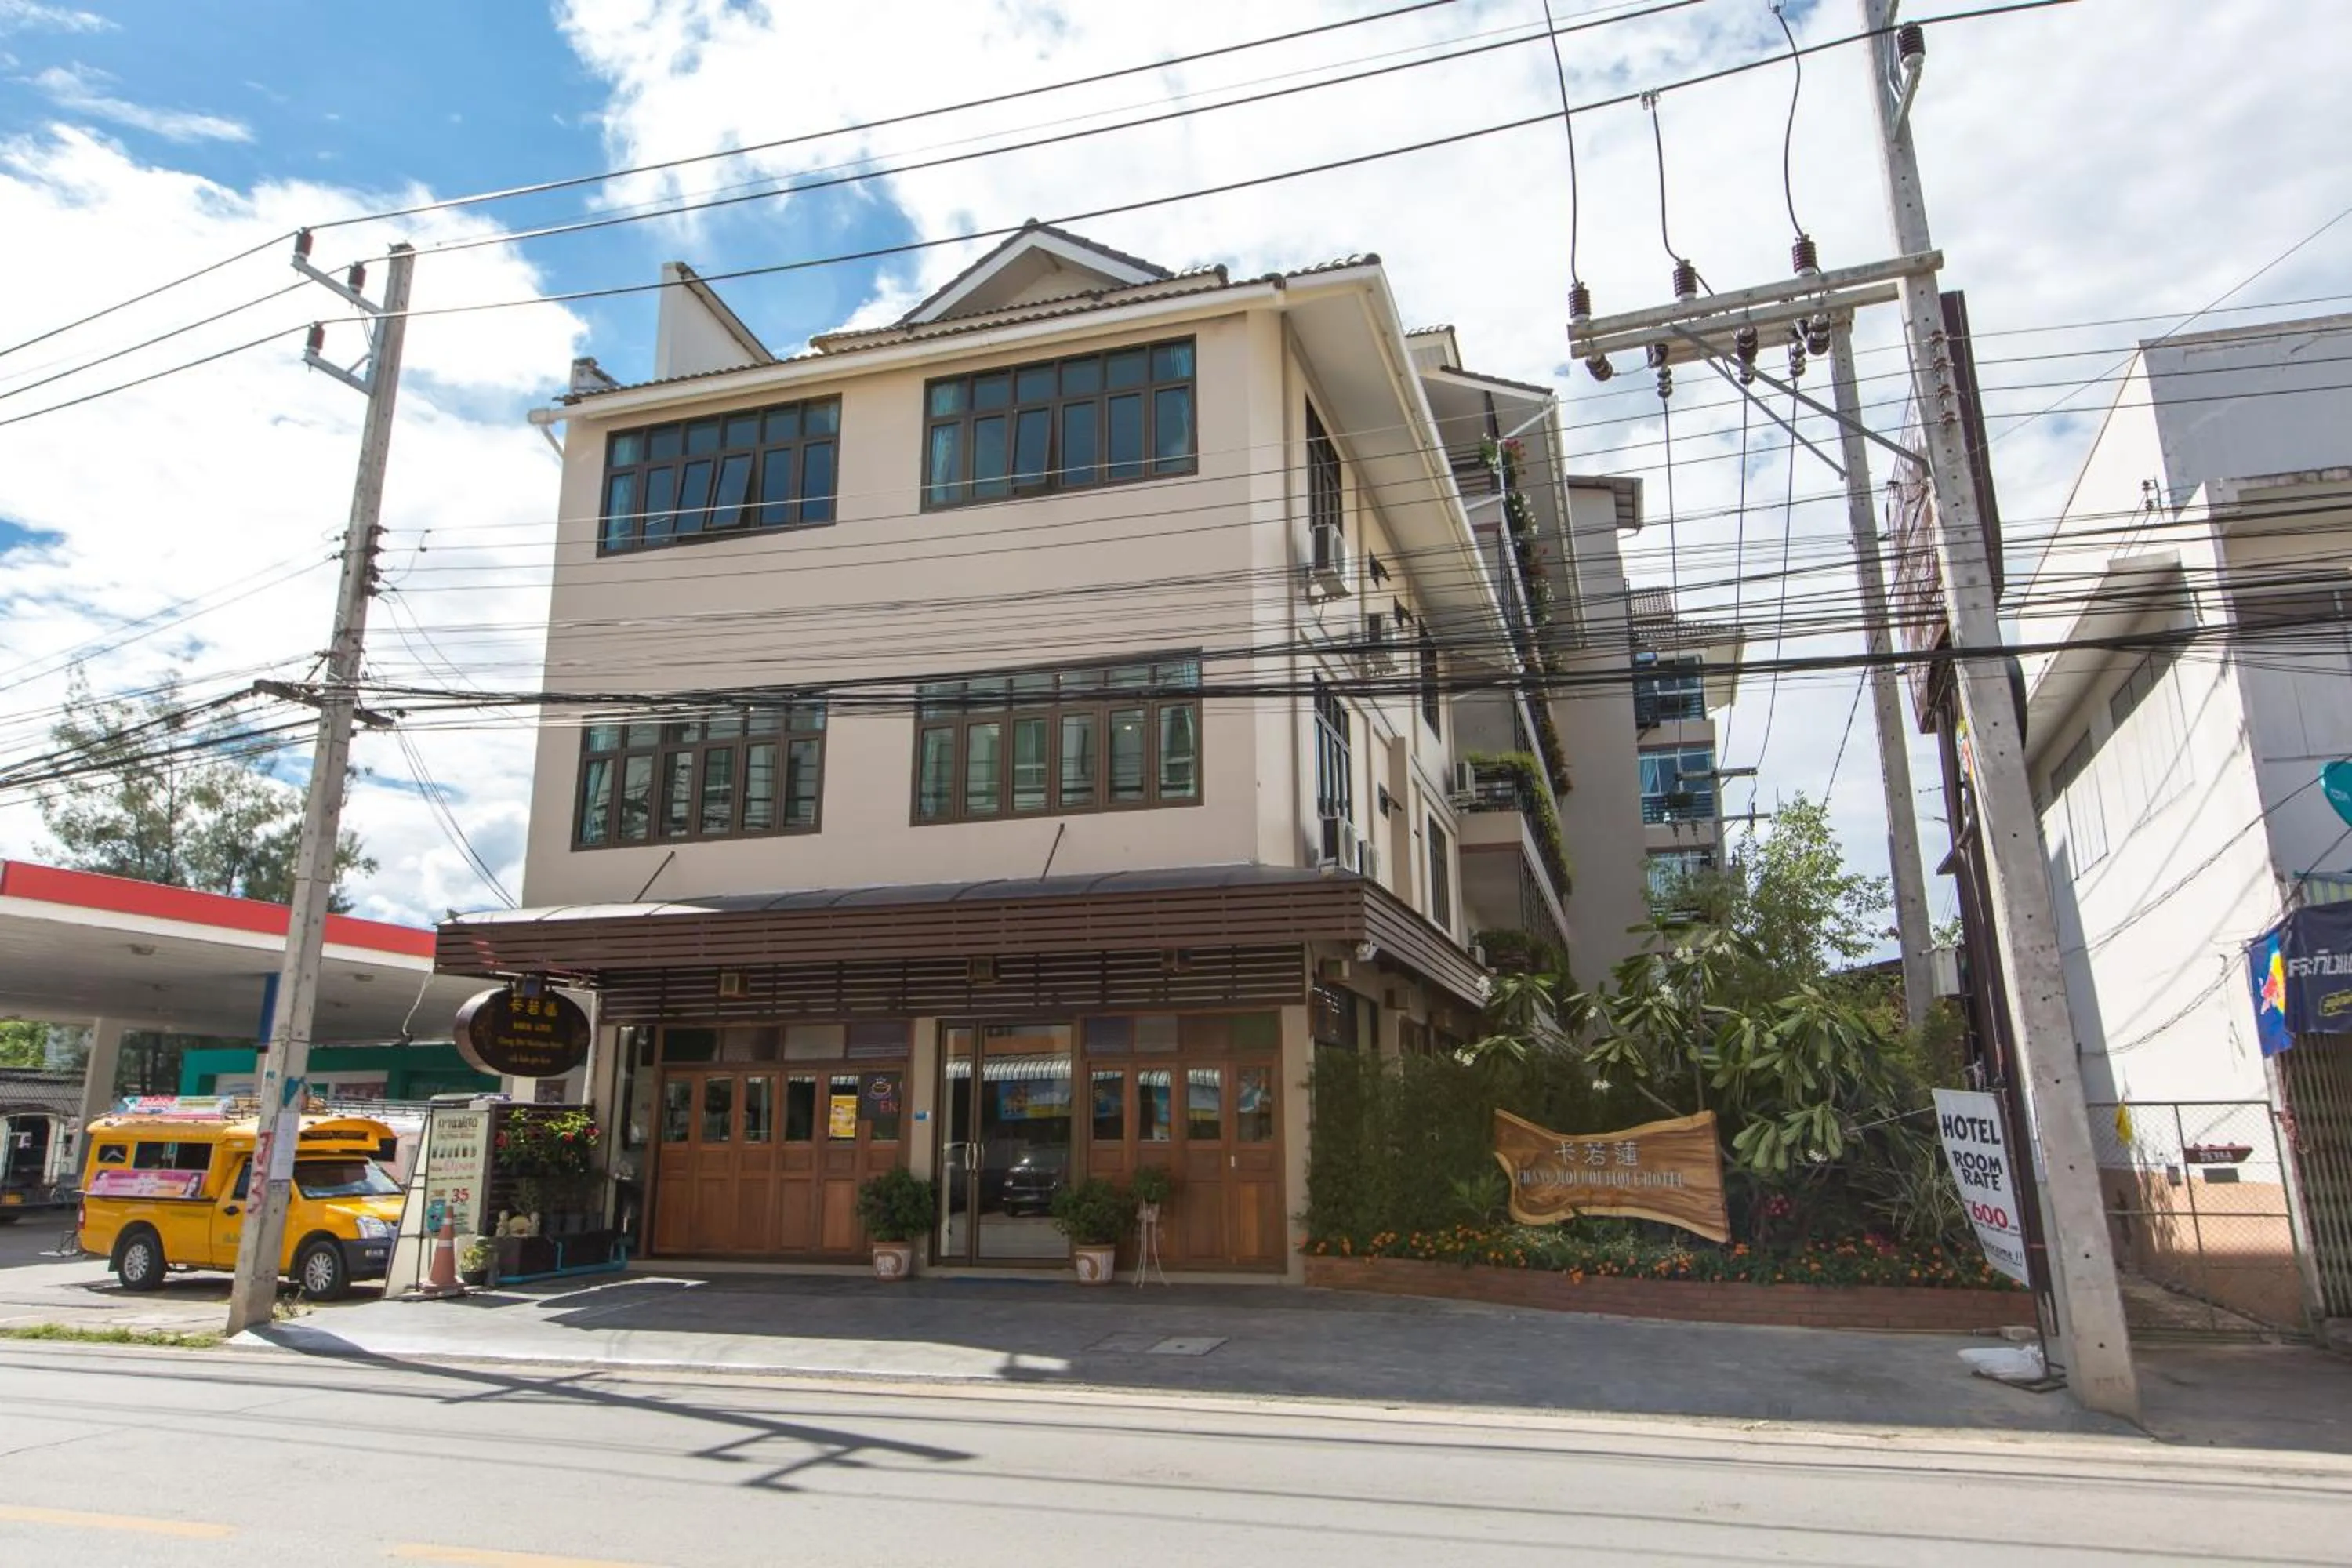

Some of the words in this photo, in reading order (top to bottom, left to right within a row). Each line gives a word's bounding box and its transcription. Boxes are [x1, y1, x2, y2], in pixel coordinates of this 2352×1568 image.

[1941, 1114, 2001, 1145] HOTEL
[1555, 1141, 1638, 1166] 卡若蓮
[1952, 1150, 2003, 1175] ROOM
[1961, 1167, 2002, 1192] RATE
[1972, 1200, 2009, 1229] 600
